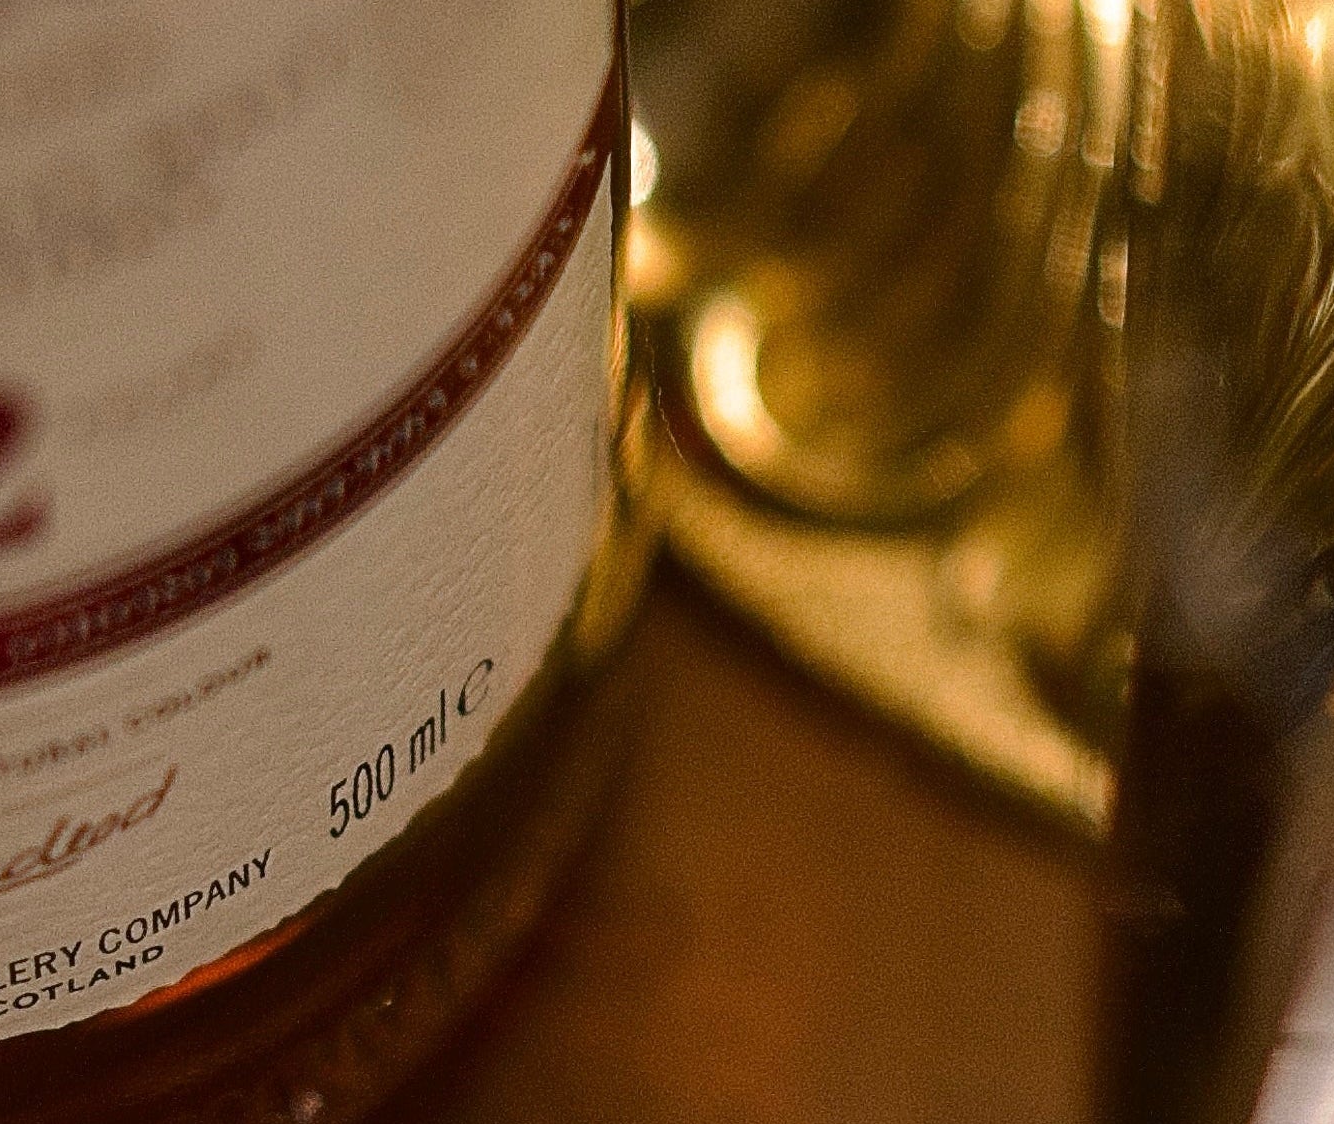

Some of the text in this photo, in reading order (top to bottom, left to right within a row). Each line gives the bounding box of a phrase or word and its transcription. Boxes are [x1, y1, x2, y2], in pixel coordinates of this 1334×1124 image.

[329, 743, 395, 839] 500
[409, 688, 446, 775] ml
[97, 847, 272, 956] COMPANY
